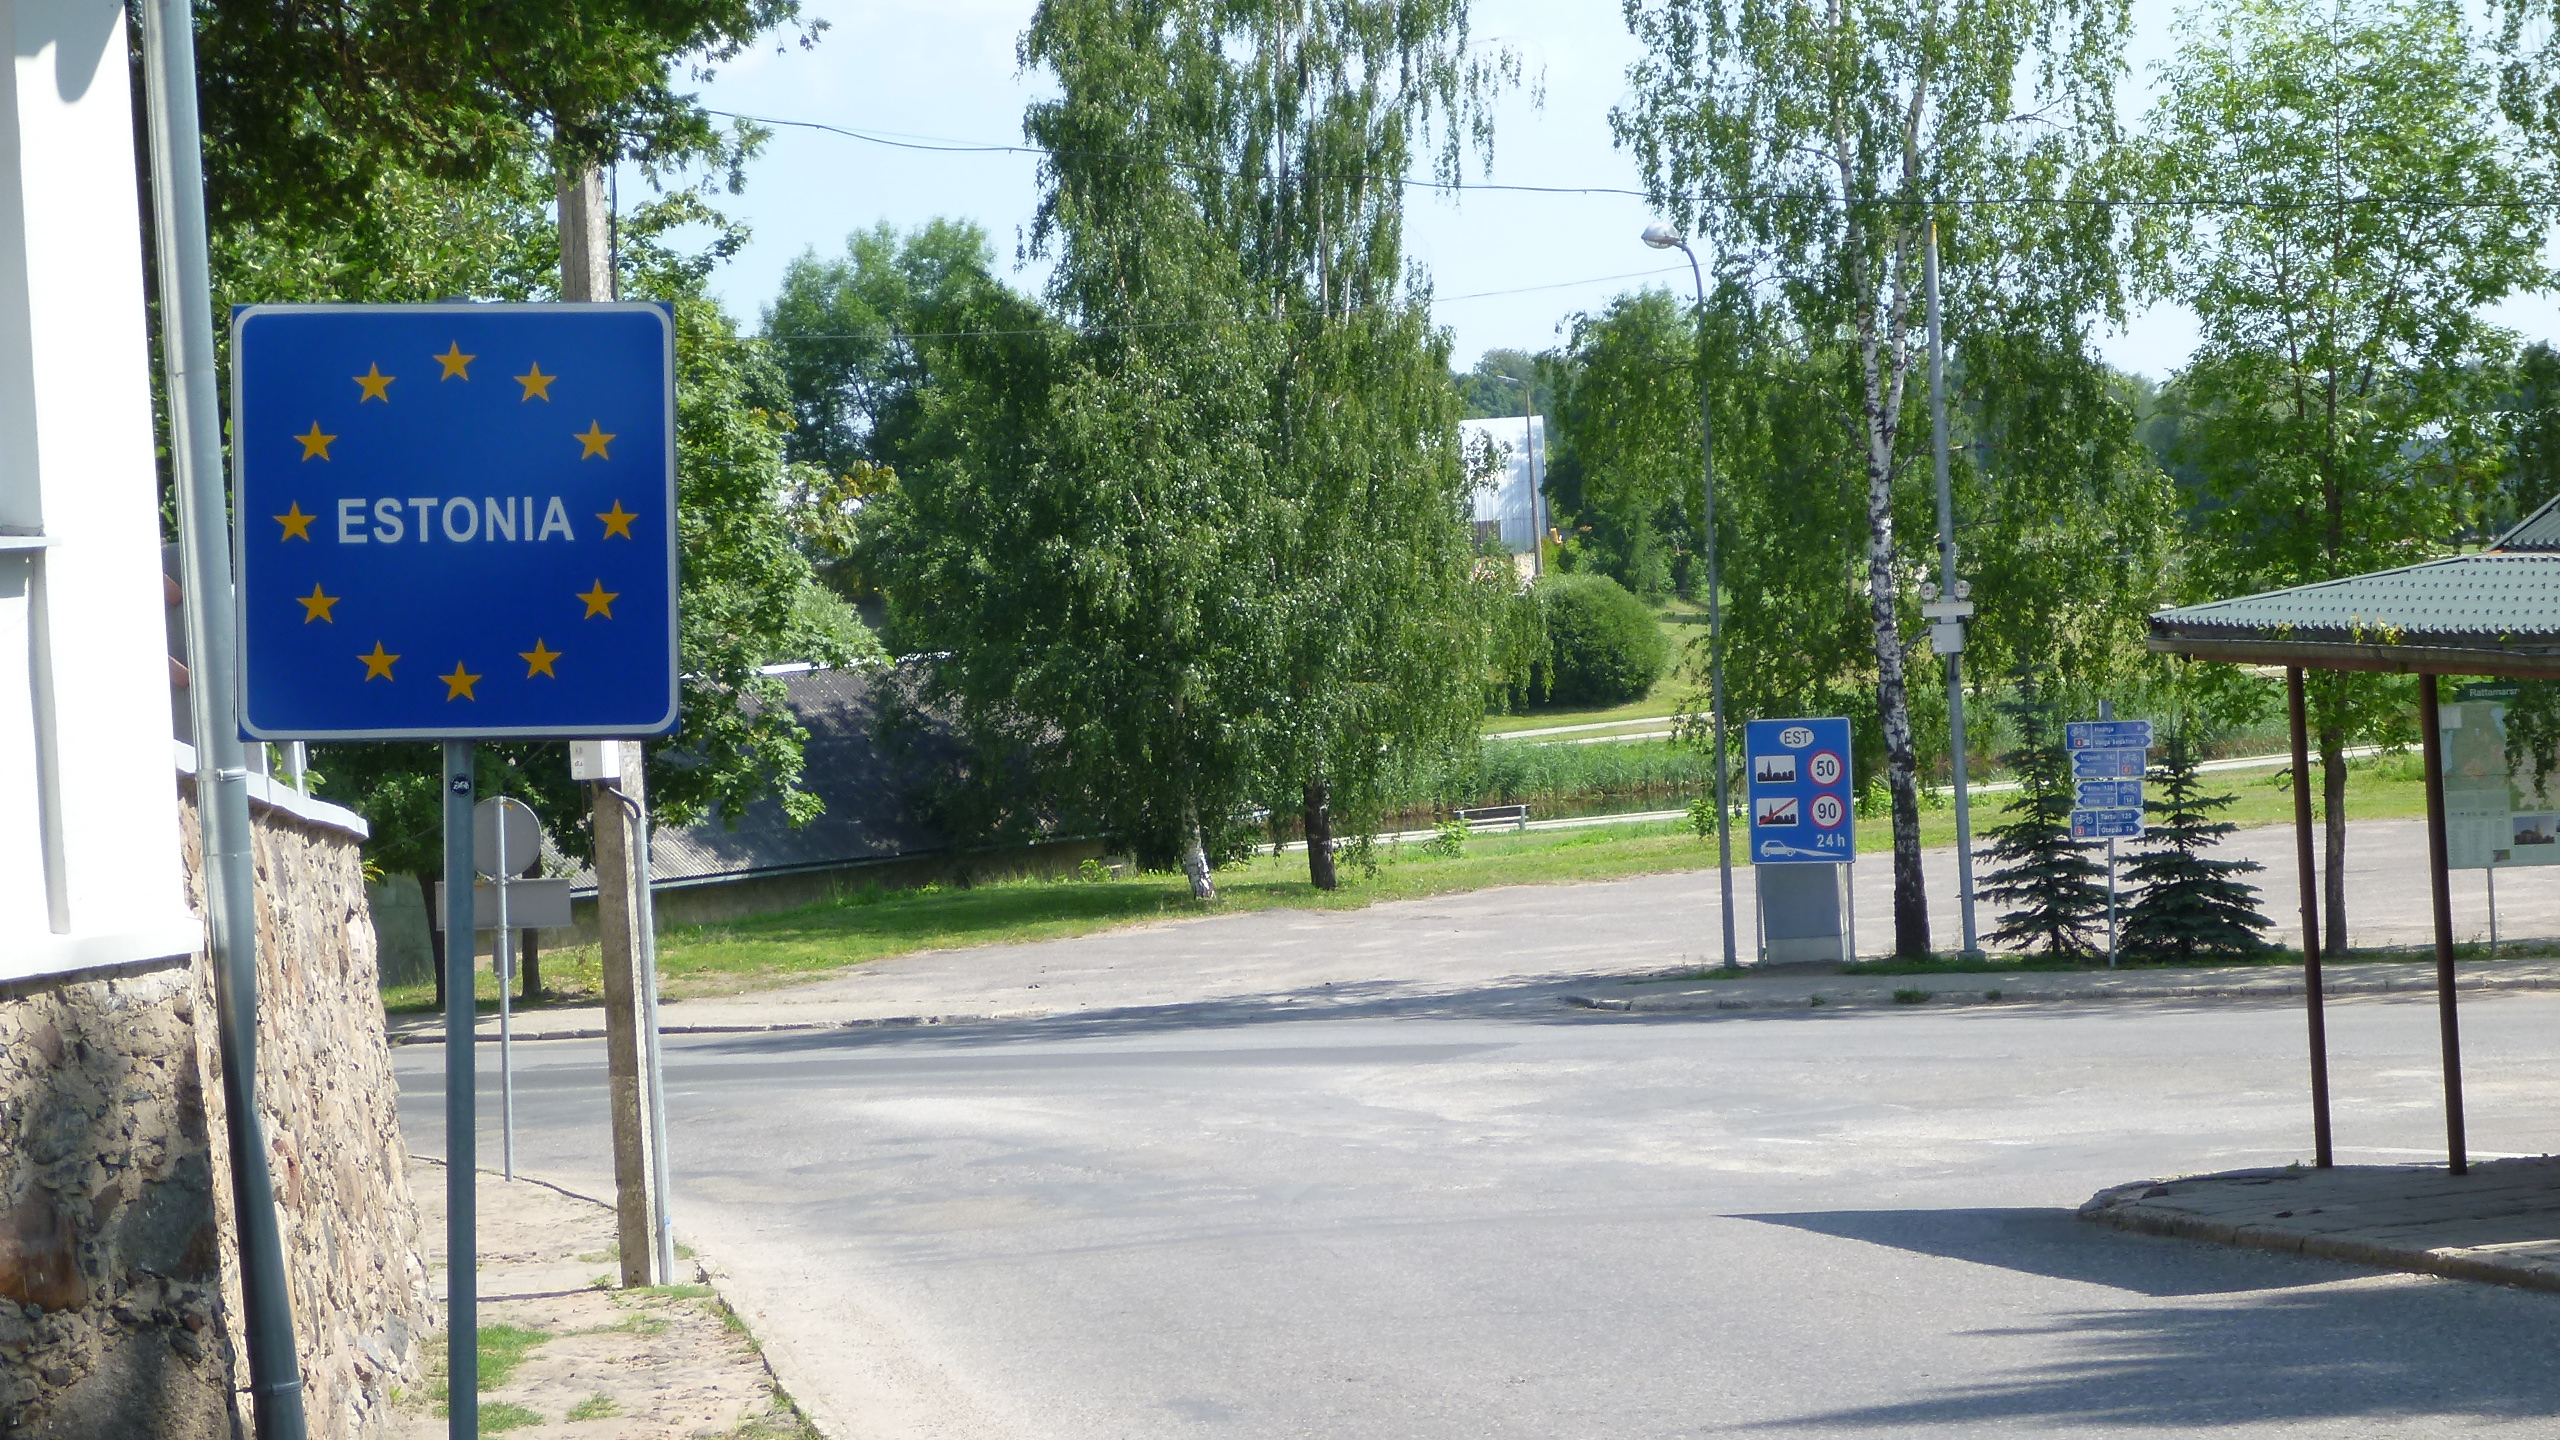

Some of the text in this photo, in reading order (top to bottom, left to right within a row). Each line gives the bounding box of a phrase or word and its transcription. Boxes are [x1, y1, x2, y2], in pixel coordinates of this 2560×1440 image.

[337, 496, 576, 544] ESTONIA
[2469, 688, 2520, 697] Rattamarsr
[1784, 731, 1810, 744] EST
[1816, 760, 1835, 777] 50
[1818, 803, 1837, 819] 90
[1817, 833, 1846, 848] 24 h
